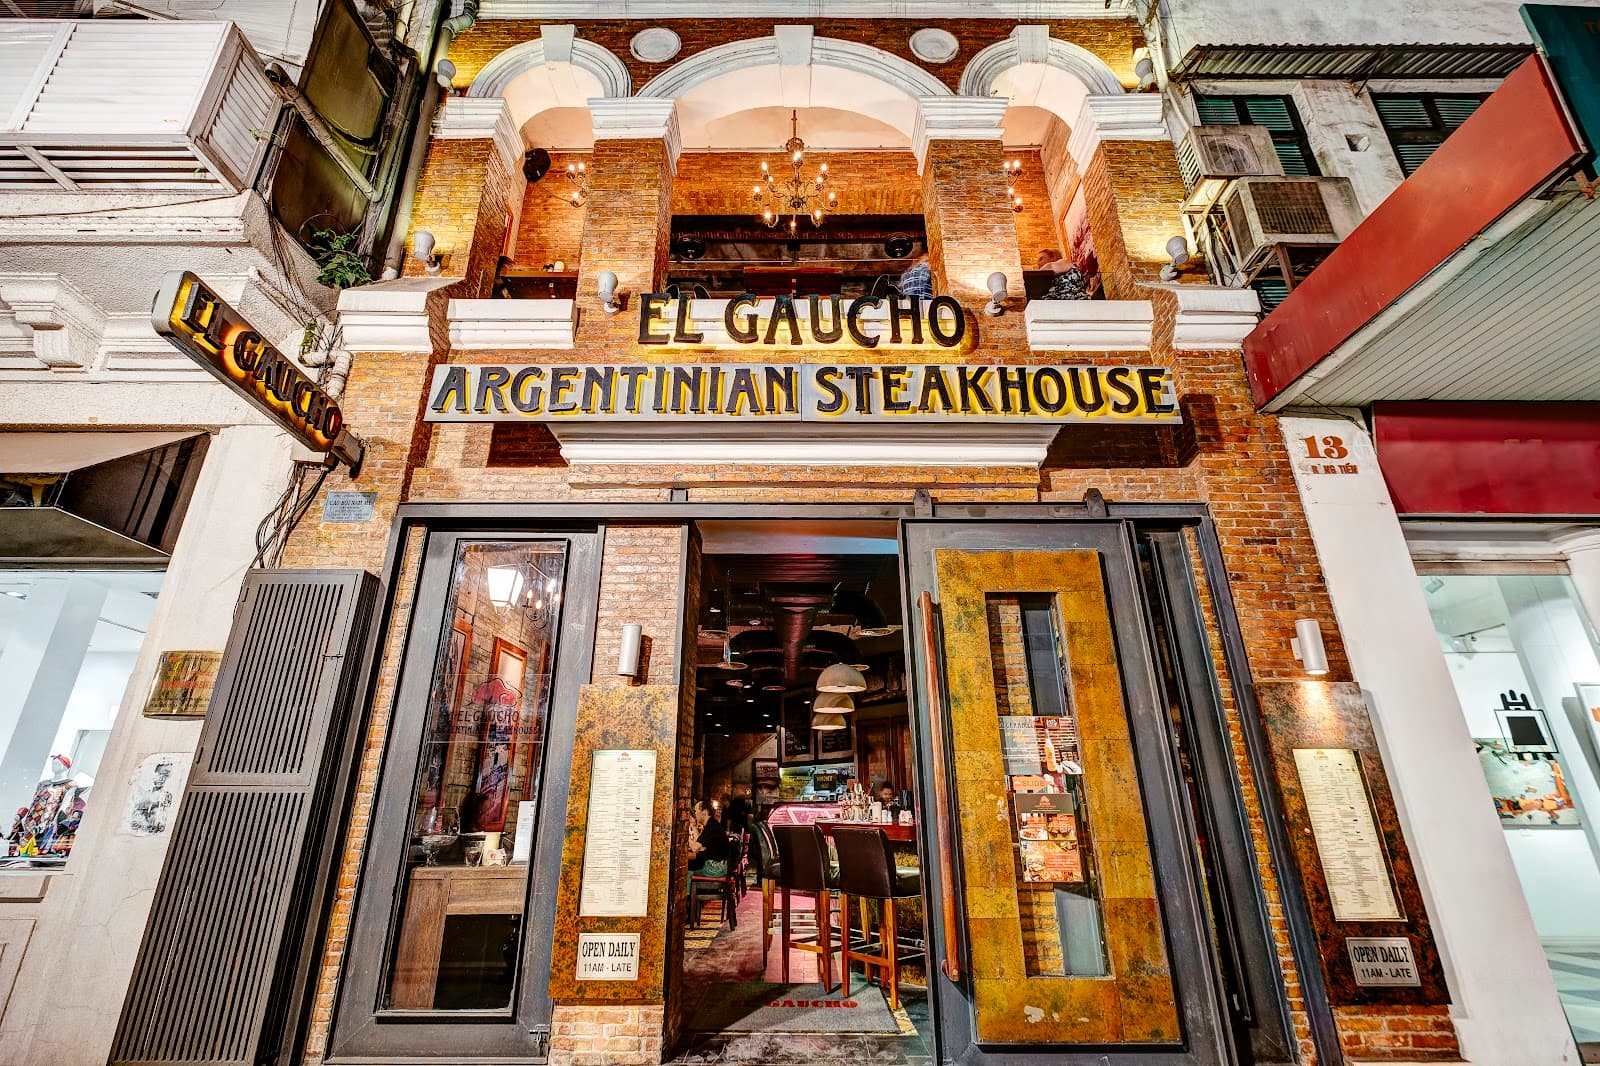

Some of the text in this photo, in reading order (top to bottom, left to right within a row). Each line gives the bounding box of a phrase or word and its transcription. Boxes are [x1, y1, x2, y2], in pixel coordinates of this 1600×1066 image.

[637, 293, 965, 348] EL GAUCHO
[180, 281, 342, 440] EL GAUCHO
[431, 365, 1175, 415] ARGENTINIAN STEAKHOUSE
[1299, 435, 1348, 459] 13
[582, 941, 636, 957] OPEN DAILY
[1353, 946, 1410, 963] OPEN DAILY
[584, 962, 604, 972] 11AM
[611, 962, 632, 972] LATE
[1361, 968, 1384, 978] 11AM
[1389, 968, 1413, 978] LATE
